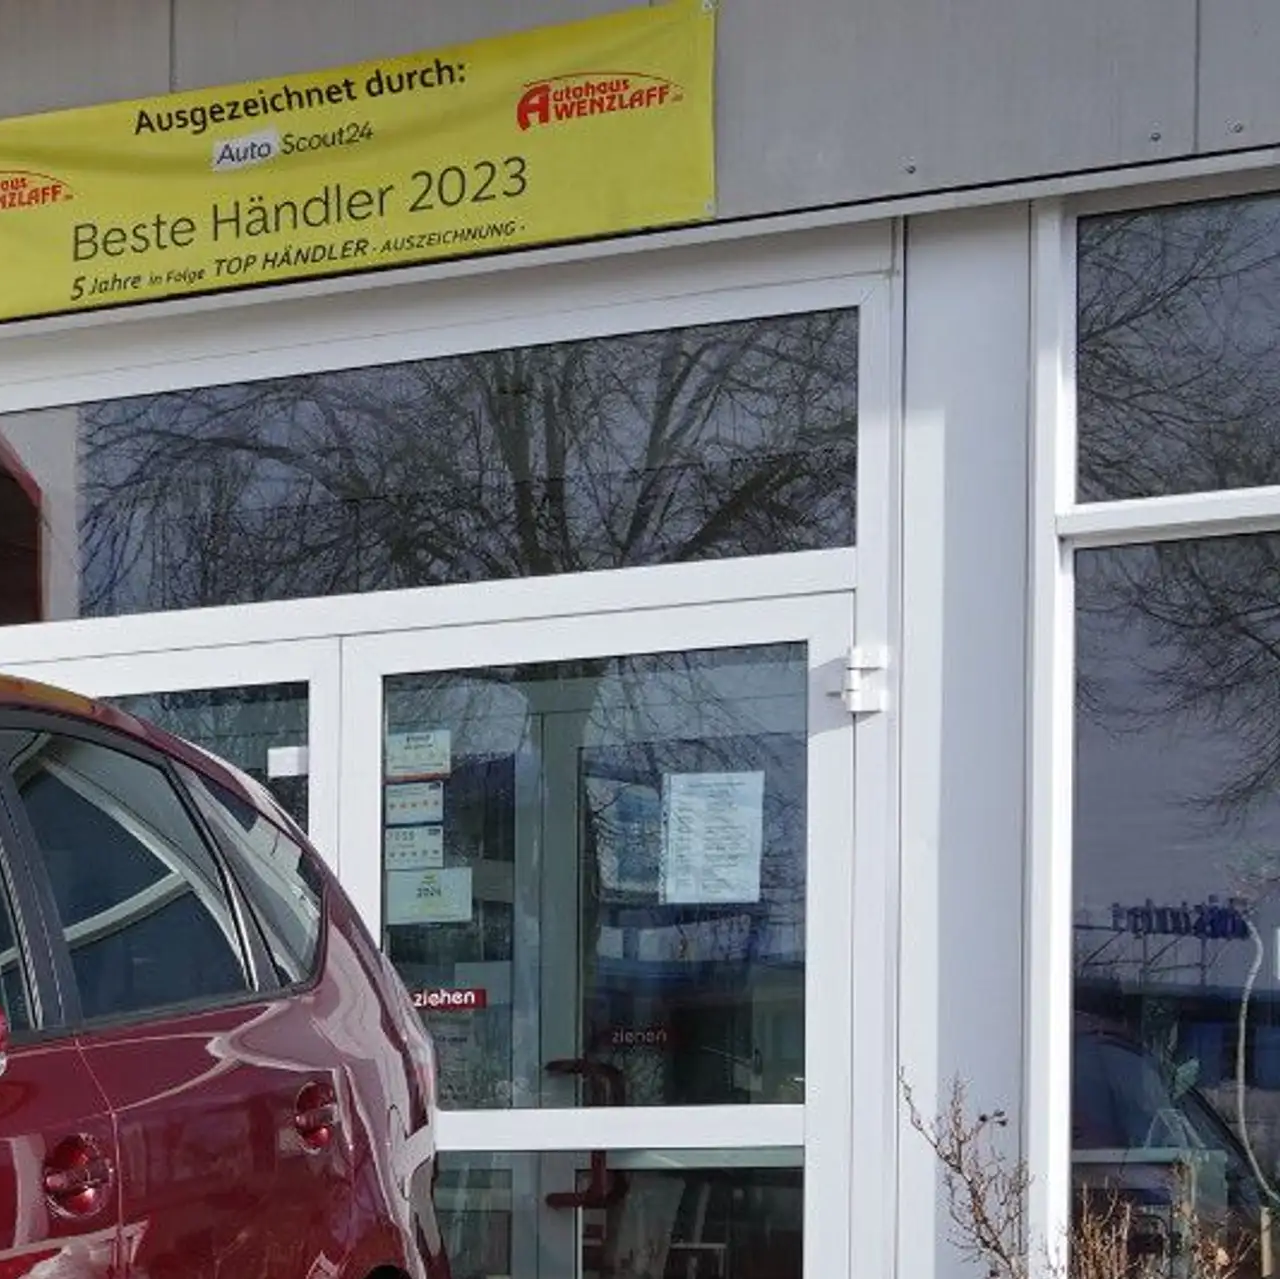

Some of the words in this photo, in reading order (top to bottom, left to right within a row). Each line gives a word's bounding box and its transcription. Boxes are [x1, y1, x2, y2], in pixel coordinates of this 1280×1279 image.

[134, 76, 357, 135] Ausgezeichnet
[365, 59, 467, 98] durch:
[516, 79, 630, 132] Autohaus
[553, 85, 670, 121] WENZLAFF
[216, 137, 273, 166] Auto
[280, 120, 376, 156] Scout24
[72, 213, 197, 262] Beste
[211, 183, 395, 242] Händler
[407, 155, 528, 213] 2023
[70, 275, 87, 301] 5
[148, 274, 163, 286] in
[166, 267, 206, 284] Folge
[214, 253, 258, 277] TOP
[261, 238, 369, 271] HÄNDLER
[413, 988, 476, 1008] ziehen
